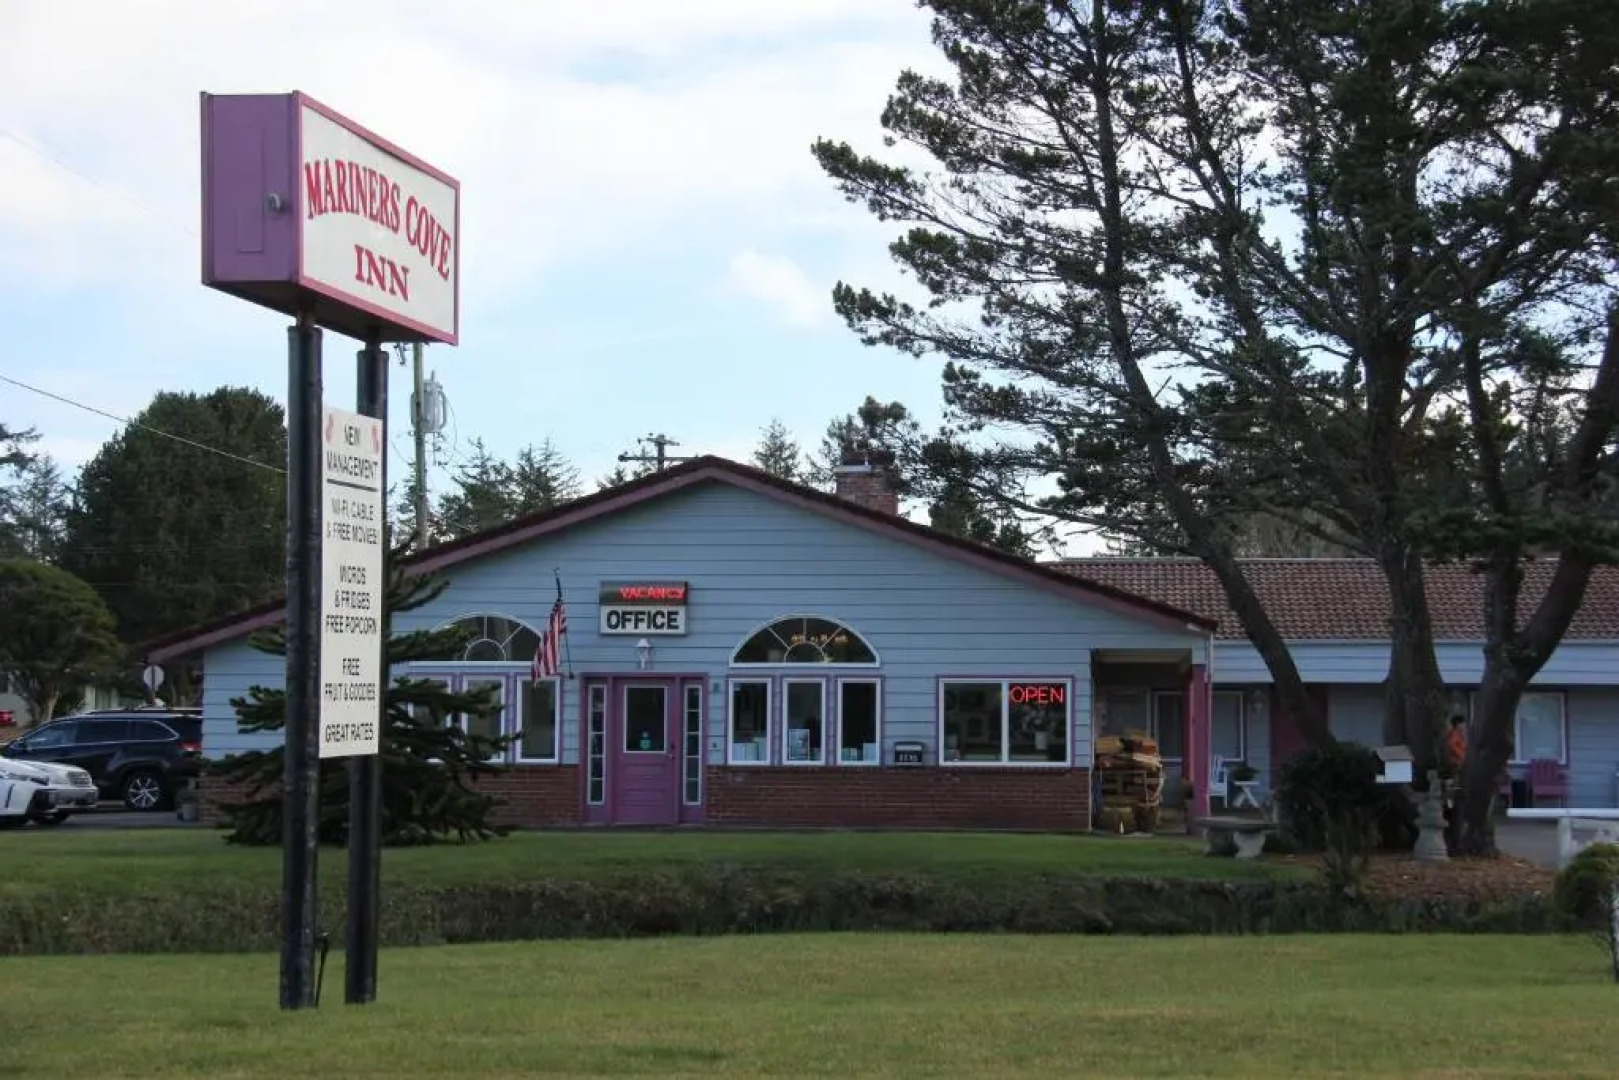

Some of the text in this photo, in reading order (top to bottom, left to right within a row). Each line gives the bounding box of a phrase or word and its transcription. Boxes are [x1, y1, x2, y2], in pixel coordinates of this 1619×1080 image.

[305, 158, 452, 281] MARINERS COVE
[354, 244, 410, 301] INN
[344, 425, 361, 446] NEW
[327, 450, 378, 479] MANAGEMENT
[333, 522, 351, 541] FREE
[341, 591, 370, 610] FRIDGES
[326, 614, 376, 635] FREE POPCORN
[606, 610, 679, 630] OFFICE
[342, 658, 360, 676] FREE
[1009, 686, 1064, 703] OPEN
[325, 722, 374, 743] GREAT RATES
